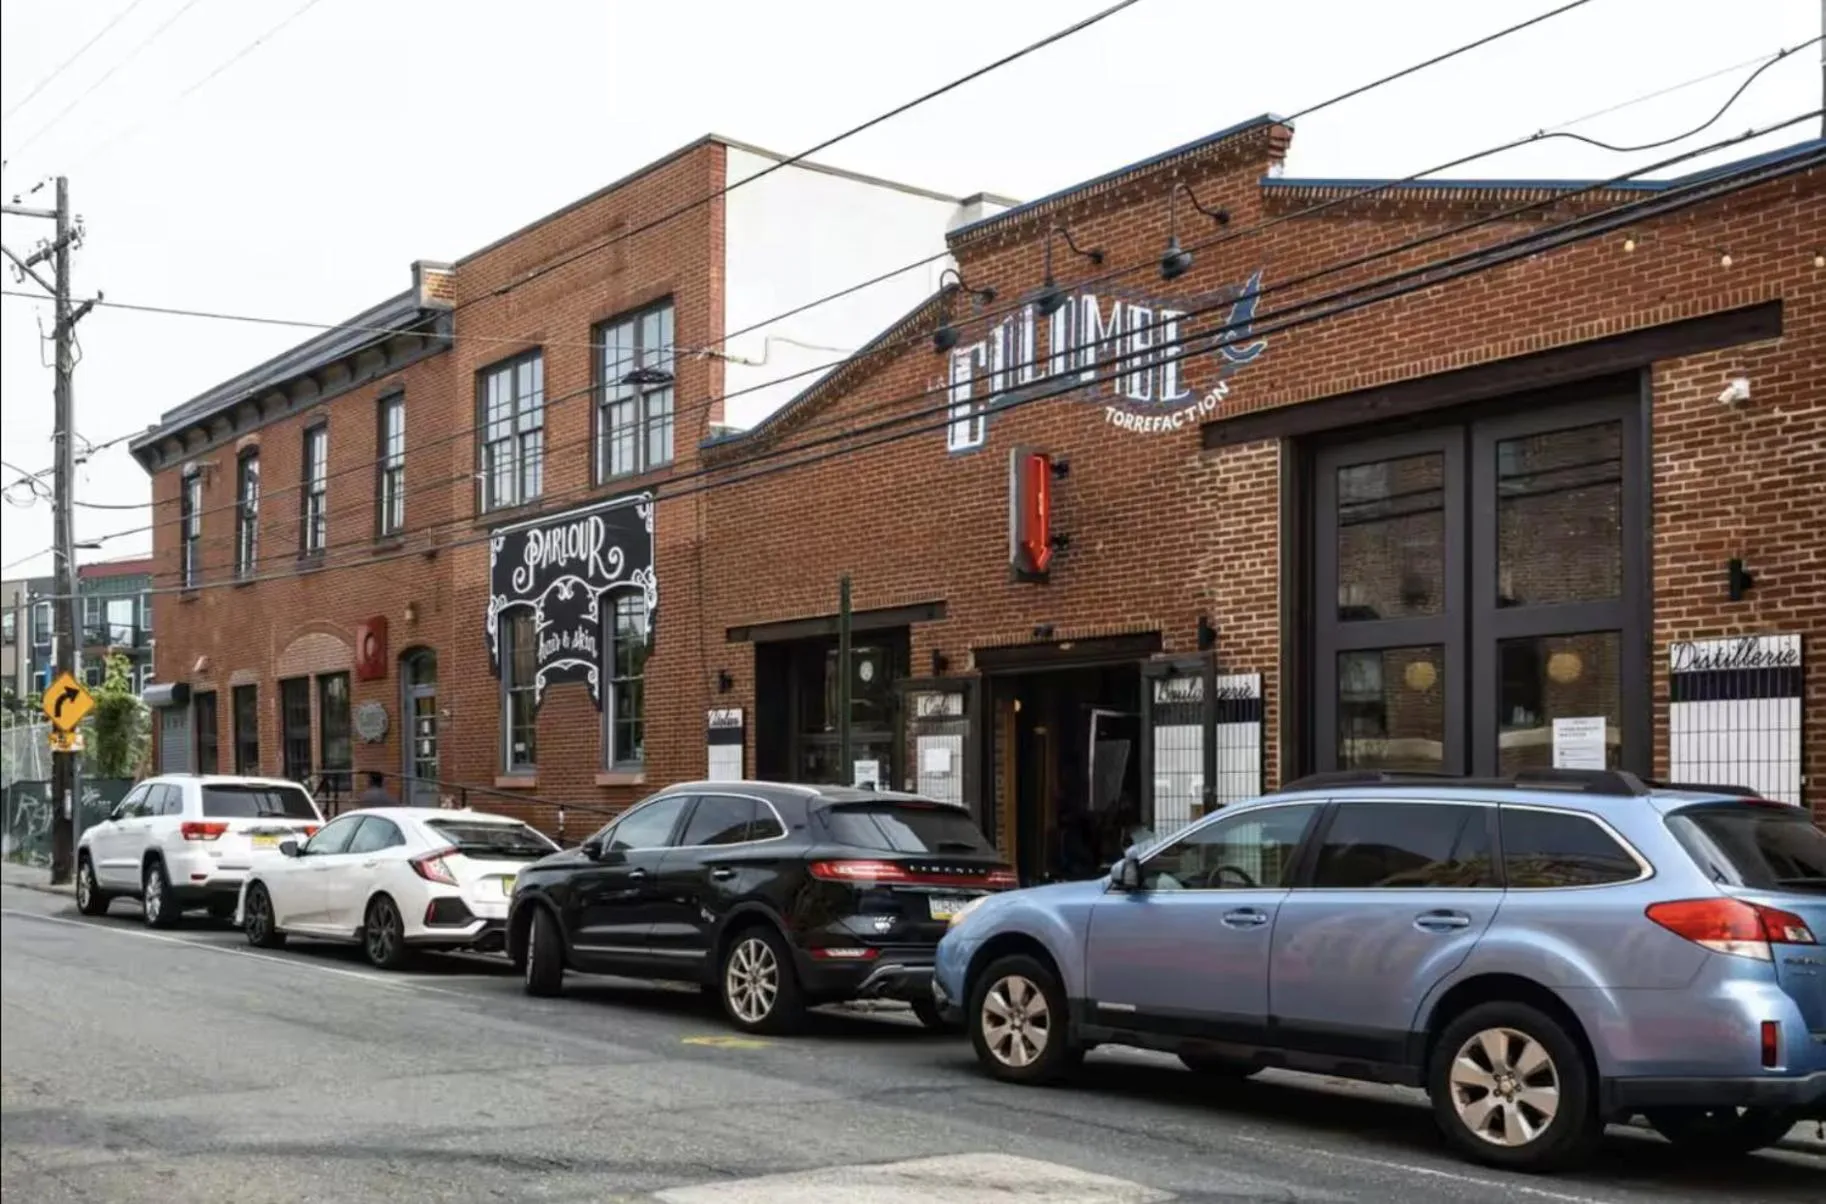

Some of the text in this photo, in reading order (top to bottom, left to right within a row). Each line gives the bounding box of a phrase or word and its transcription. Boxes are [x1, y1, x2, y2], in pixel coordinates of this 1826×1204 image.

[1104, 380, 1230, 433] TORREFACTION
[512, 515, 625, 594] PARLOUR
[571, 625, 597, 658] skin
[1673, 638, 1797, 670] Distillerie
